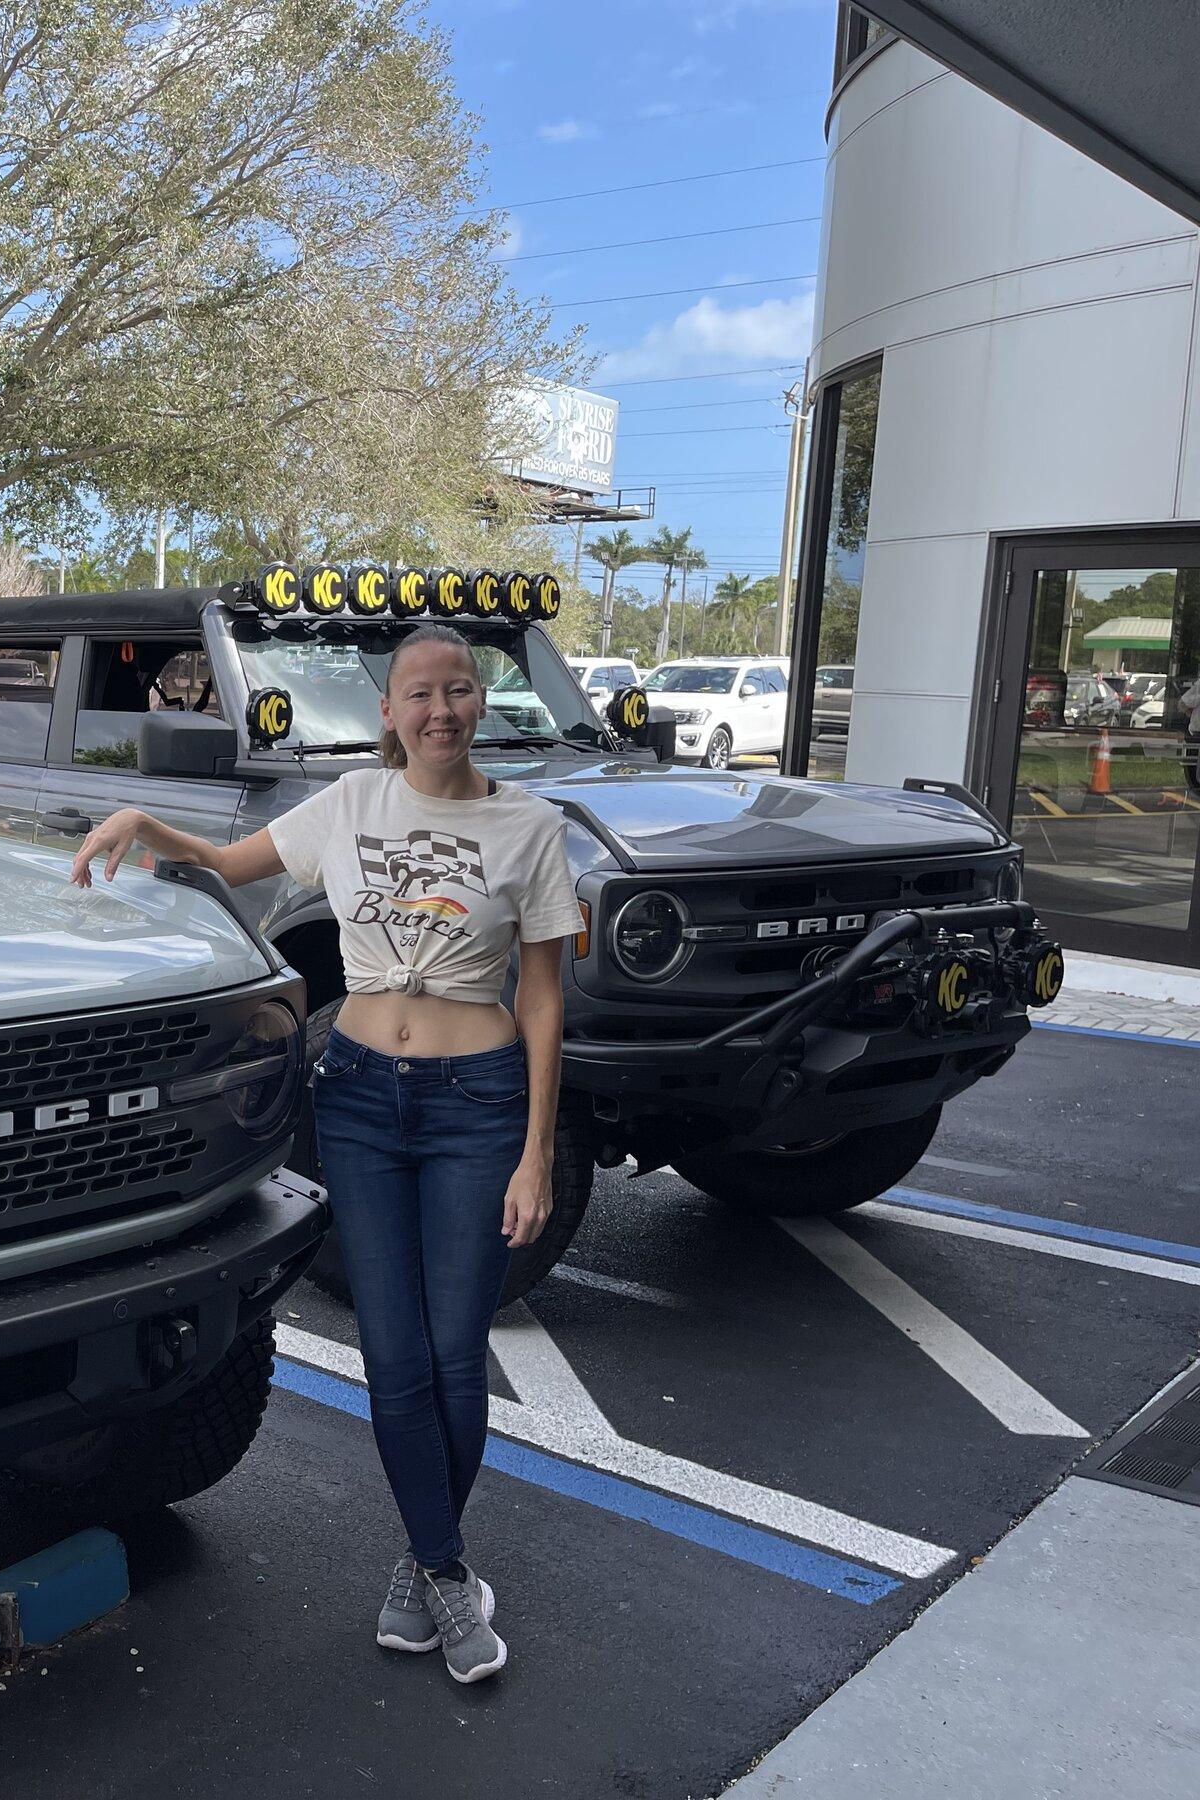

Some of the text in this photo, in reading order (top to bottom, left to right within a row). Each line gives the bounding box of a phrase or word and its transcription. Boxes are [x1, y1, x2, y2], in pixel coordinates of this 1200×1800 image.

[559, 397, 614, 432] SUNRISE
[266, 568, 296, 608] KC
[313, 569, 342, 608] KC
[358, 570, 386, 609] KC
[400, 571, 425, 609] KC
[439, 573, 463, 610] KC
[476, 574, 499, 611] KC
[510, 576, 530, 612] KC
[540, 578, 559, 613] KC
[259, 694, 288, 735] KC
[623, 692, 646, 729] KC
[346, 889, 473, 941] Bronco
[937, 962, 968, 1013] KC
[1035, 952, 1061, 1000] KC
